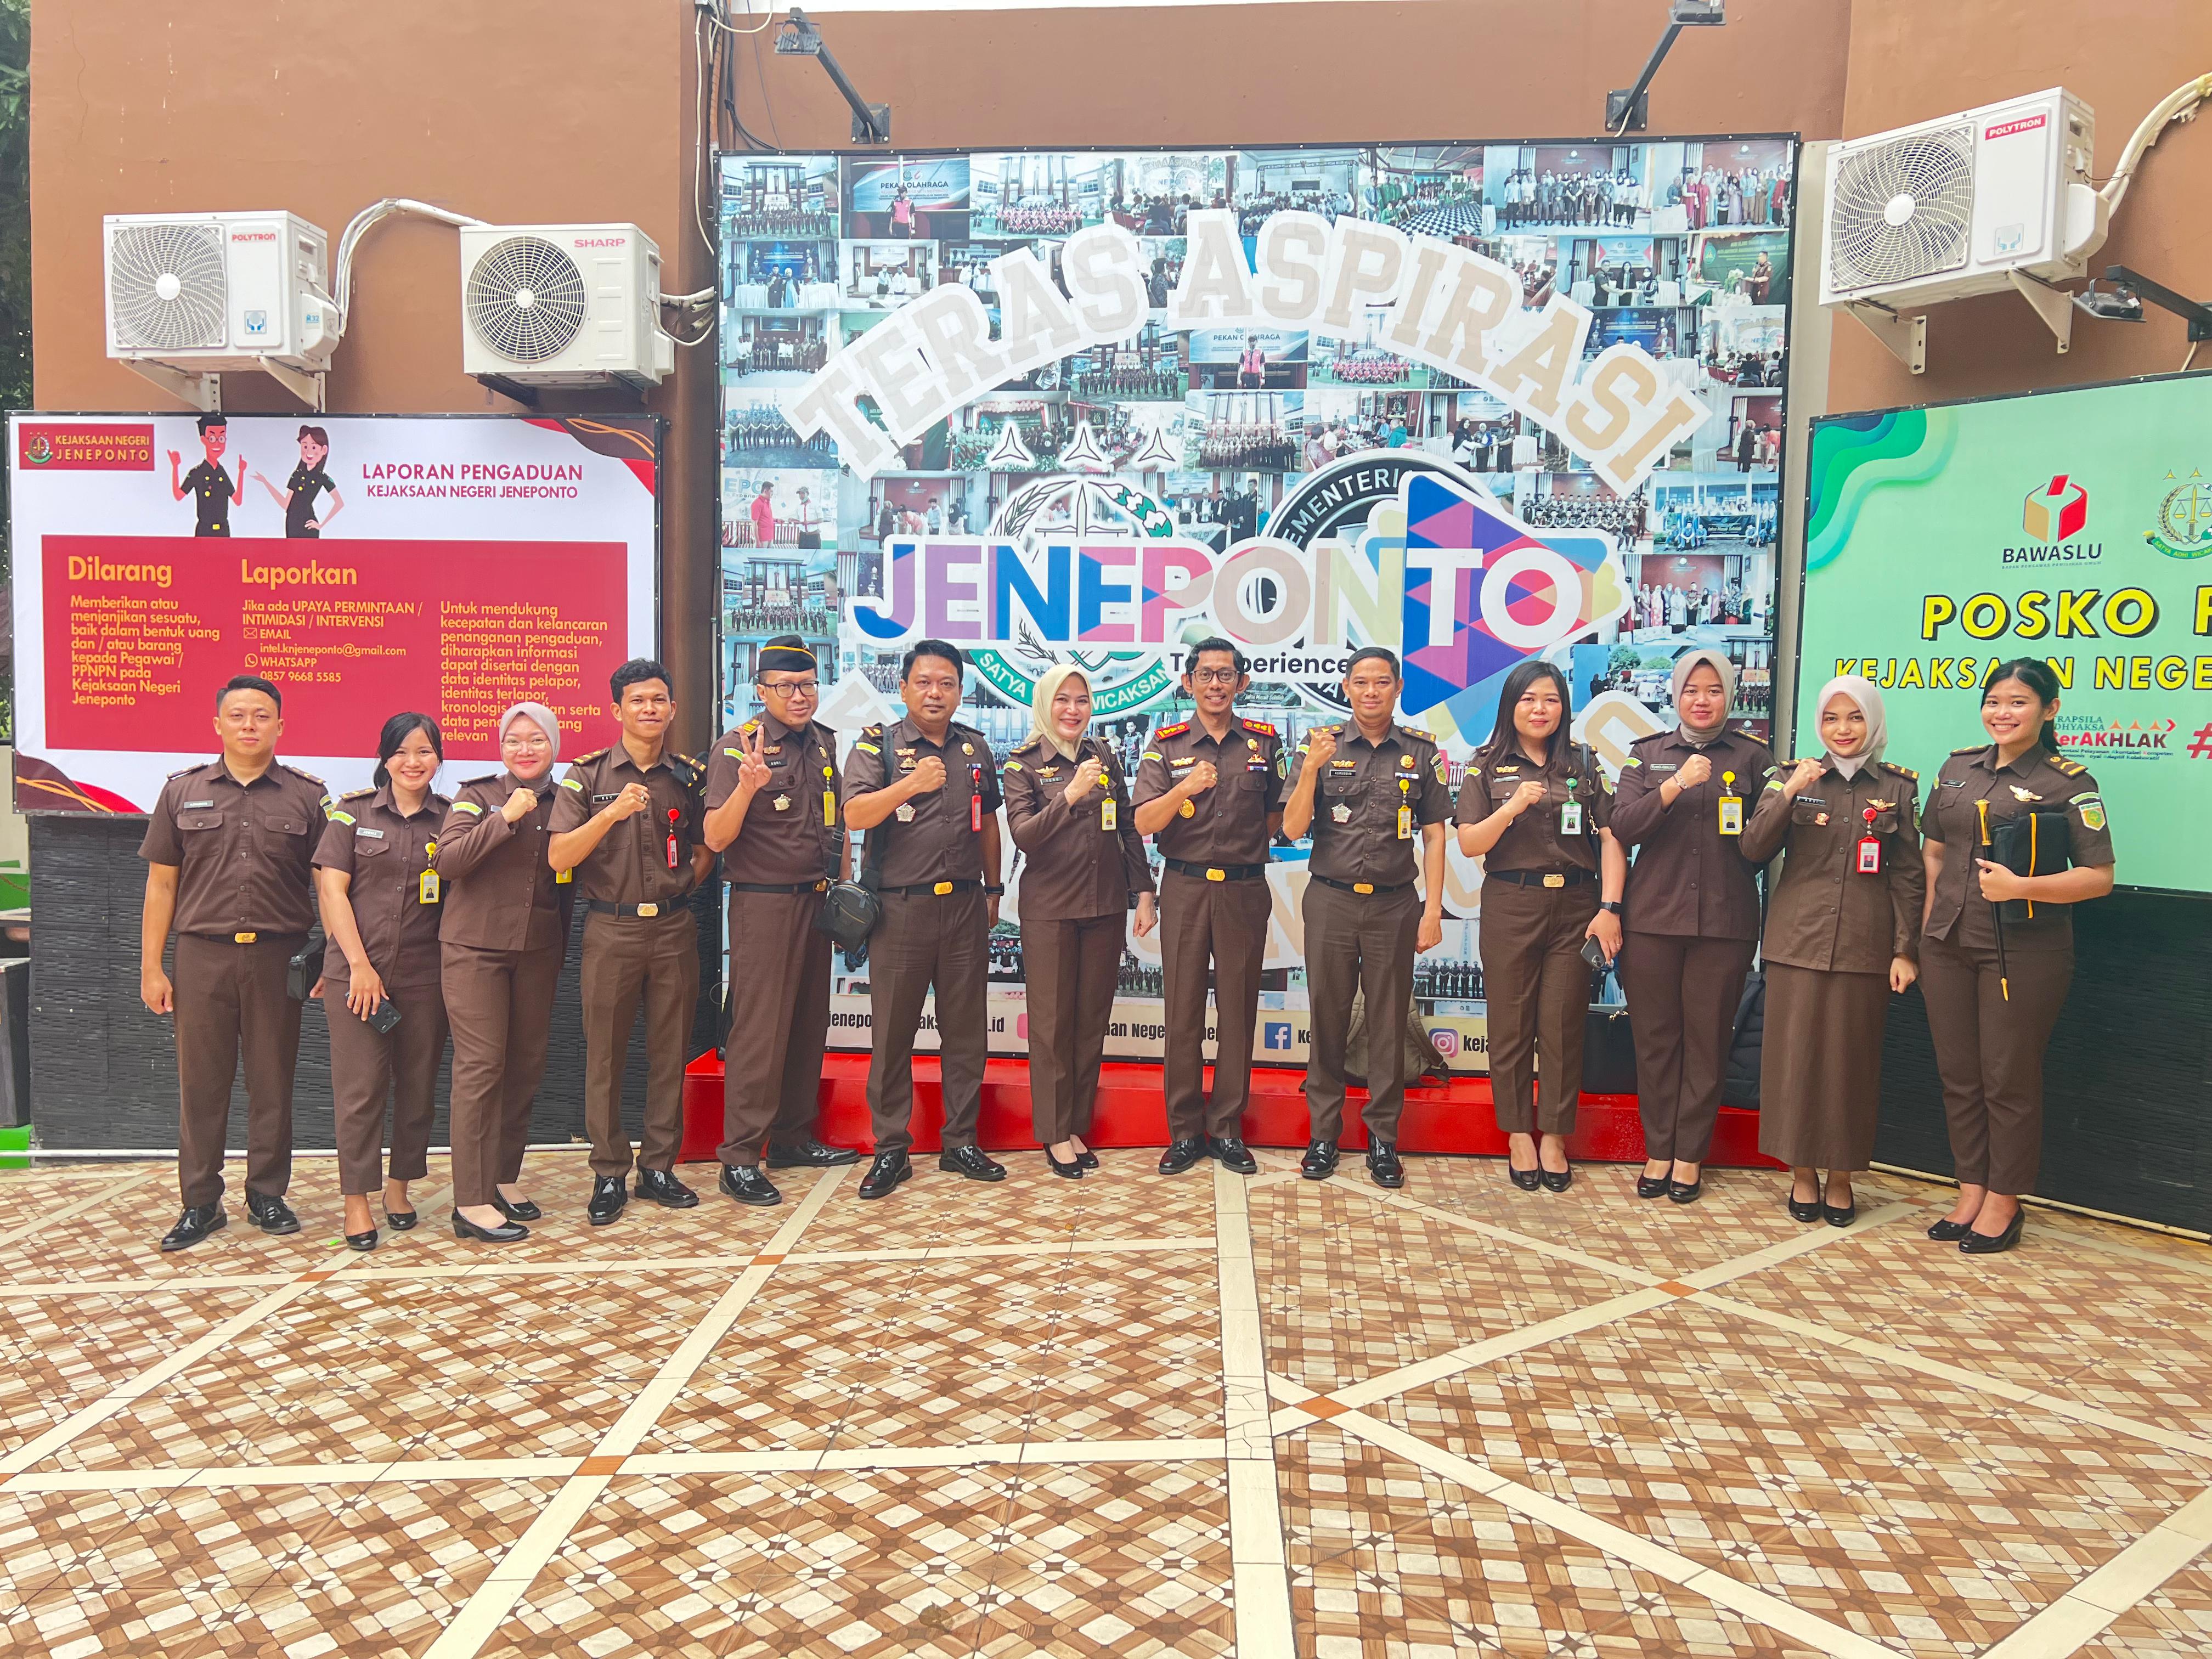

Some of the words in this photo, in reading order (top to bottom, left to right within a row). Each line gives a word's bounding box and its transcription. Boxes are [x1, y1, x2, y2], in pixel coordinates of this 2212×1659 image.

[1989, 117, 2042, 137] POLYTRON
[574, 238, 625, 247] SHARP
[793, 233, 1139, 476] TERAS
[1179, 221, 1695, 484] ASPIRASI
[55, 436, 112, 445] KEJAKSAAN
[115, 436, 149, 445] NEGERI
[57, 449, 149, 461] JENEPONTO
[363, 464, 454, 479] LAPORAN
[461, 464, 582, 481] PENGADUAN
[367, 485, 447, 498] KEJAKSAAN
[450, 486, 495, 498] NEGERI
[500, 486, 577, 498] JENEPONTO
[1282, 468, 1399, 547] EMENTERI
[2002, 543, 2102, 563] BAWASLU
[68, 556, 172, 588] Dilarang
[241, 558, 357, 590] Laporkan
[71, 595, 147, 608] Memberikan
[151, 598, 178, 610] atau
[854, 544, 1582, 648] JENEPONTO
[242, 600, 265, 612] Jika
[268, 600, 289, 612] ada
[292, 601, 330, 612] UPAYA
[335, 601, 414, 614] PERMINTAAN
[441, 601, 477, 614] Untuk
[482, 602, 558, 618] mendukung
[1921, 586, 2159, 641] POSKO
[71, 610, 146, 625] menjanjikan
[150, 613, 200, 625] sesuatu,
[243, 614, 305, 625] INTIMIDASI
[317, 615, 383, 627] INTERVENSI
[441, 616, 504, 631] kecepatan
[509, 616, 533, 629] dan
[537, 617, 607, 630] kelancaran
[71, 623, 97, 636] baik
[100, 624, 139, 636] dalam
[144, 624, 184, 637] bentuk
[189, 629, 220, 641] uang
[260, 629, 291, 639] EMAIL
[441, 633, 521, 645] penanganan
[526, 632, 602, 647] pengaduan,
[71, 636, 94, 649] dan
[107, 639, 134, 650] atau
[138, 638, 182, 654] barang
[260, 643, 406, 657] intel.knjeneponto@gmail.com
[441, 644, 512, 659] diharapkan
[517, 645, 577, 658] informasi
[72, 651, 117, 665] kepada
[120, 652, 174, 667] Pegawai
[261, 657, 317, 667] WHATSAPP
[441, 658, 477, 673] dapat
[481, 658, 527, 672] disertai
[531, 659, 579, 675] dengan
[72, 664, 116, 677] PPNPN
[120, 667, 151, 680] pada
[260, 671, 285, 681] 0857
[289, 672, 313, 681] 9668
[317, 672, 341, 682] 5585
[980, 653, 1025, 698] SATYA
[72, 678, 137, 693] Kejaksaan
[140, 680, 180, 696] Negeri
[441, 673, 469, 685] data
[473, 673, 526, 686] identitas
[529, 674, 580, 690] pelapor,
[72, 692, 136, 708] Jeneponto
[442, 686, 493, 699] identitas
[497, 687, 549, 703] terlapor,
[442, 701, 506, 716] kronologis
[570, 705, 601, 715] serta
[442, 715, 469, 727] data
[558, 719, 582, 732] ang
[442, 729, 488, 741] relevan
